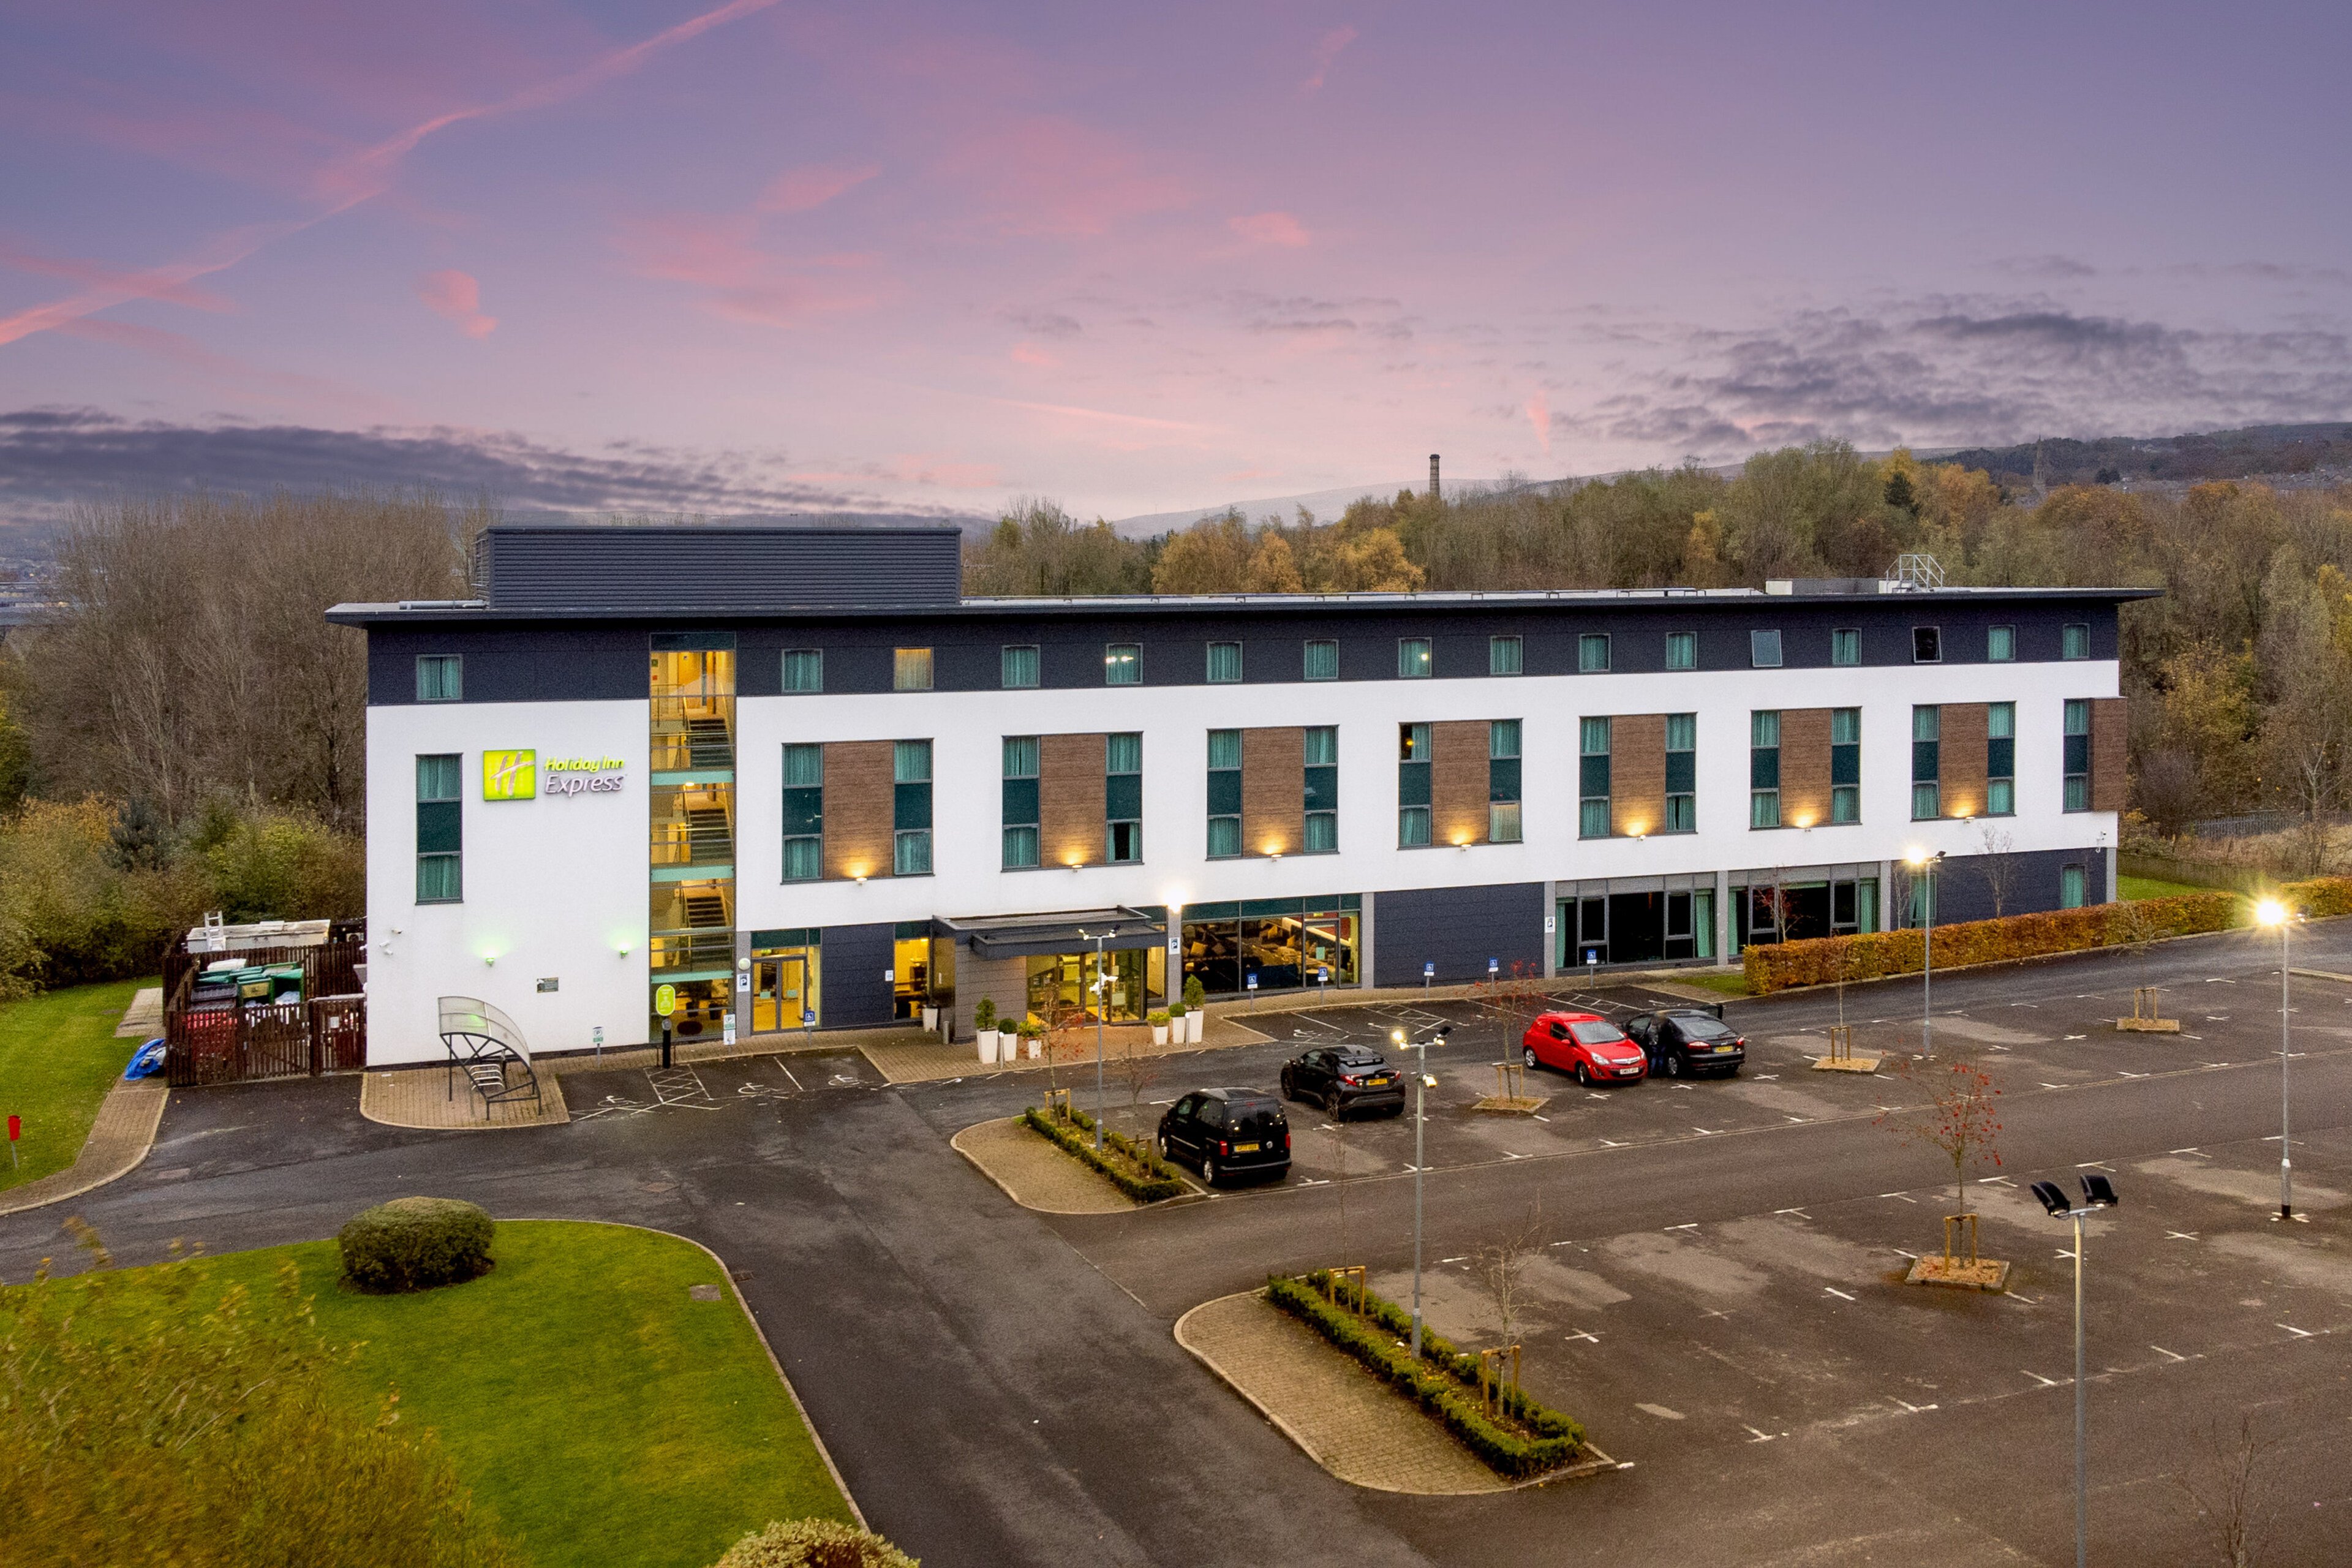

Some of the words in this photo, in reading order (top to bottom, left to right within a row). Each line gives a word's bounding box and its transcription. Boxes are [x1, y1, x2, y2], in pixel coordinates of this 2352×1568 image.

[545, 756, 600, 772] Holiday
[602, 755, 624, 769] Inn
[545, 774, 624, 797] Express
